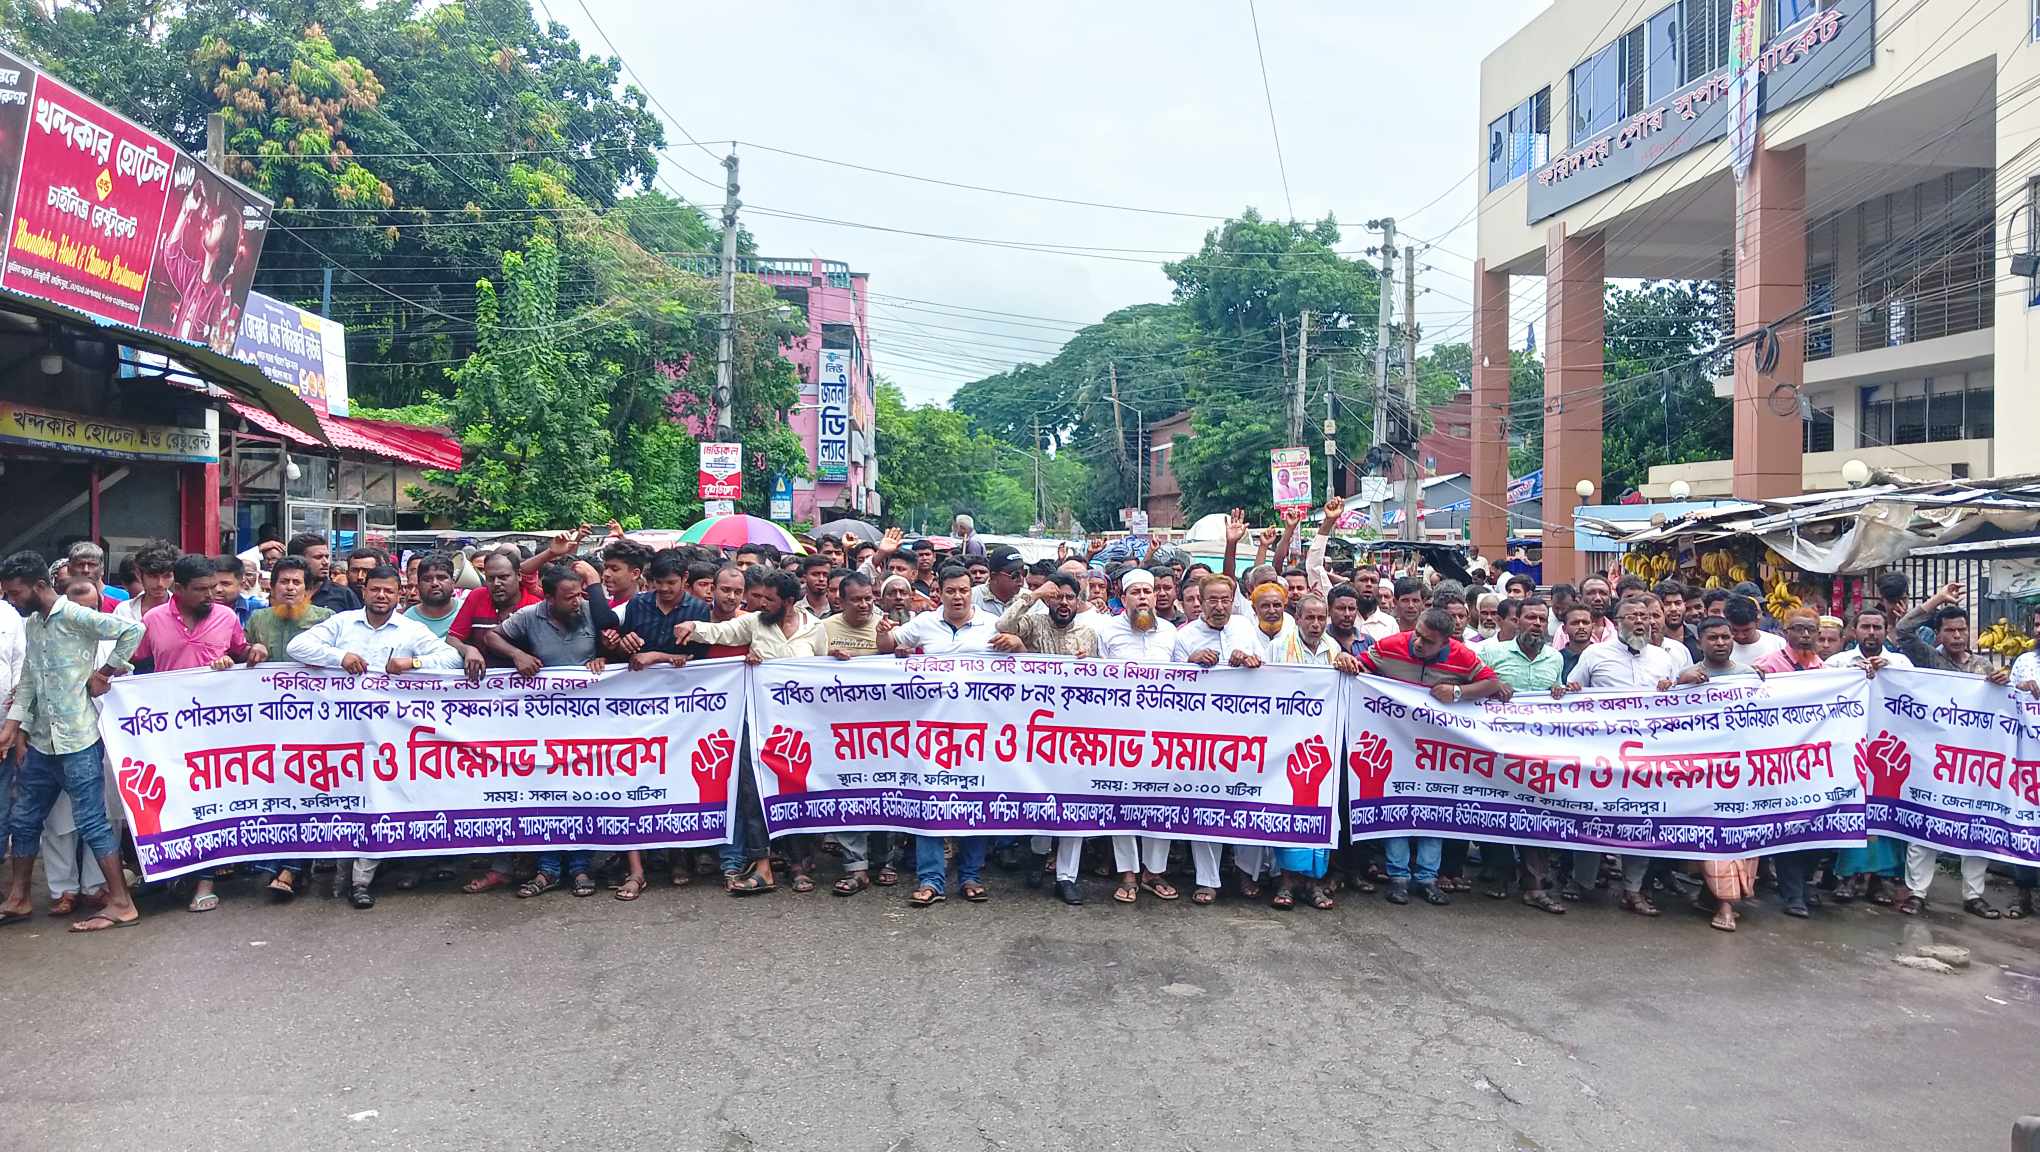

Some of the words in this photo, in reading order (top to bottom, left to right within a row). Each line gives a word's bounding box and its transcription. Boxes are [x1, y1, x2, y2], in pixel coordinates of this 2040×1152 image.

[36, 98, 114, 165] খন্দকার
[116, 139, 169, 191] হোটেল
[1617, 106, 1665, 149] পৌর
[48, 185, 90, 220] চাইনিজ
[821, 374, 847, 405] জননী
[13, 410, 78, 438] খন্দকার
[85, 423, 136, 449] হোটেল
[821, 406, 846, 436] ডি
[821, 439, 846, 461] ল্যাব
[331, 674, 355, 690] দাও
[361, 672, 390, 692] সেই
[486, 676, 504, 690] হে
[509, 674, 547, 690] মিথ্যা
[960, 660, 984, 672] দাও
[990, 656, 1016, 674] সেই
[1020, 661, 1068, 677] অরণ্য,
[1074, 664, 1098, 677] লও
[1103, 664, 1119, 680] হে
[1124, 662, 1159, 681] মিথ্যা
[119, 706, 168, 737] বর্ধিত
[175, 697, 253, 730] পৌরসভা
[258, 693, 313, 721] বাতিল
[318, 701, 329, 720] ও
[335, 700, 390, 721] সাবেক
[397, 699, 436, 720] ৮নং
[442, 699, 519, 725] কৃষ্ণনগর
[524, 692, 600, 718] ইউনিয়নে
[606, 696, 670, 717] বহালের
[675, 687, 728, 714] দাবিতে
[770, 680, 814, 706] বর্ধিত
[820, 674, 886, 704] পৌরসভা
[892, 675, 942, 700] বাতিল
[946, 682, 960, 700] ও
[964, 682, 1016, 702] সাবেক
[1021, 683, 1056, 705] ৮নং
[1060, 685, 1131, 712] কৃষ্ণনগর
[1136, 684, 1205, 712] ইউনিয়নে
[1211, 693, 1271, 715] বহালের
[1276, 690, 1325, 717] দাবিতে
[1568, 697, 1594, 714] সেই
[1599, 696, 1649, 711] অরণ্য,
[1685, 693, 1702, 705] হে
[1884, 694, 1928, 720] বর্ধিত
[1932, 698, 1995, 729] পৌরসভা
[1363, 695, 1406, 720] বর্ধিত
[1411, 701, 1476, 729] পৌরসভা
[1530, 722, 1543, 736] ও
[1549, 720, 1600, 738] সাবেক
[1648, 714, 1719, 740] কৃষ্ণনগর
[1724, 704, 1780, 731] ইউনিয়নে
[1782, 703, 1826, 724] বহালের
[1827, 695, 1865, 718] দাবিতে
[184, 743, 276, 792] মানব
[282, 742, 364, 792] বন্ধন
[373, 743, 397, 782] ও
[407, 725, 538, 781] বিক্ষোভ
[545, 736, 668, 778] সমাবেশ
[831, 720, 911, 761] মানব
[915, 720, 988, 769] বন্ধন
[995, 724, 1017, 763] ও
[1027, 709, 1146, 768] বিক্ষোভ
[1151, 731, 1267, 774] সমাবেশ
[837, 773, 868, 787] স্থান:
[872, 772, 897, 783] প্রেস
[924, 771, 985, 791] ফরিদপুর।
[1415, 737, 1498, 778] মানব
[1503, 753, 1582, 794] বন্ধন
[1590, 756, 1612, 788] ও
[1619, 740, 1741, 789] বিক্ষোভ
[1746, 740, 1835, 787] সমাবেশ
[1933, 743, 2006, 790] মানব
[483, 790, 524, 803] সময়:
[528, 789, 567, 802] সকাল
[627, 787, 667, 802] ঘটিকা
[1091, 779, 1128, 792] সময়:
[1132, 781, 1169, 793] সকাল
[1225, 783, 1263, 798] ঘটিকা
[1392, 781, 1421, 794] স্থান:
[1425, 781, 1458, 794] জেলা
[1462, 784, 1509, 799] প্রশাসক
[1514, 791, 1535, 803] এর
[1603, 798, 1667, 815] ফরিদপুর।
[1713, 801, 1749, 814] সময়:
[1752, 798, 1782, 810] সকাল
[1909, 786, 1937, 802] স্থান:
[1942, 793, 1974, 809] জেলা
[2015, 810, 2034, 822] এর
[192, 804, 223, 821] স্থান:
[229, 797, 257, 812] প্রেস
[262, 797, 296, 812] ক্লাব,
[300, 793, 366, 811] ফরিদপুর।
[770, 801, 803, 822] প্রচারে:
[805, 798, 837, 818] সাবেক
[838, 797, 881, 823] কৃষ্ণনগর
[989, 796, 1019, 822] পশ্চিম
[1062, 802, 1116, 827] মহারাজপুর,
[1119, 804, 1180, 830] শ্যামসুন্দরপুর
[1182, 807, 1190, 824] ও
[1249, 806, 1291, 834] সর্বস্তরের
[1895, 806, 1925, 830] সাবেক
[1925, 815, 1969, 839] কৃষ্ণনগর
[160, 836, 192, 860] সাবেক
[192, 827, 238, 860] কৃষ্ণনগর
[239, 820, 298, 845] ইউনিয়নের
[371, 816, 405, 843] পশ্চিম
[454, 817, 516, 843] মহারাজপুর,
[518, 815, 583, 842] শ্যামসুন্দরপুর
[586, 816, 594, 835] ও
[655, 808, 699, 834] সর্বস্তরের
[1381, 804, 1409, 822] সাবেক
[1410, 805, 1453, 828] কৃষ্ণনগর
[1455, 803, 1508, 829] ইউনিয়নের
[1582, 817, 1615, 838] পশ্চিম
[1658, 824, 1718, 850] মহারাজপুর,
[1775, 822, 1783, 838] ও
[1825, 809, 1865, 833] সর্বস্তরের
